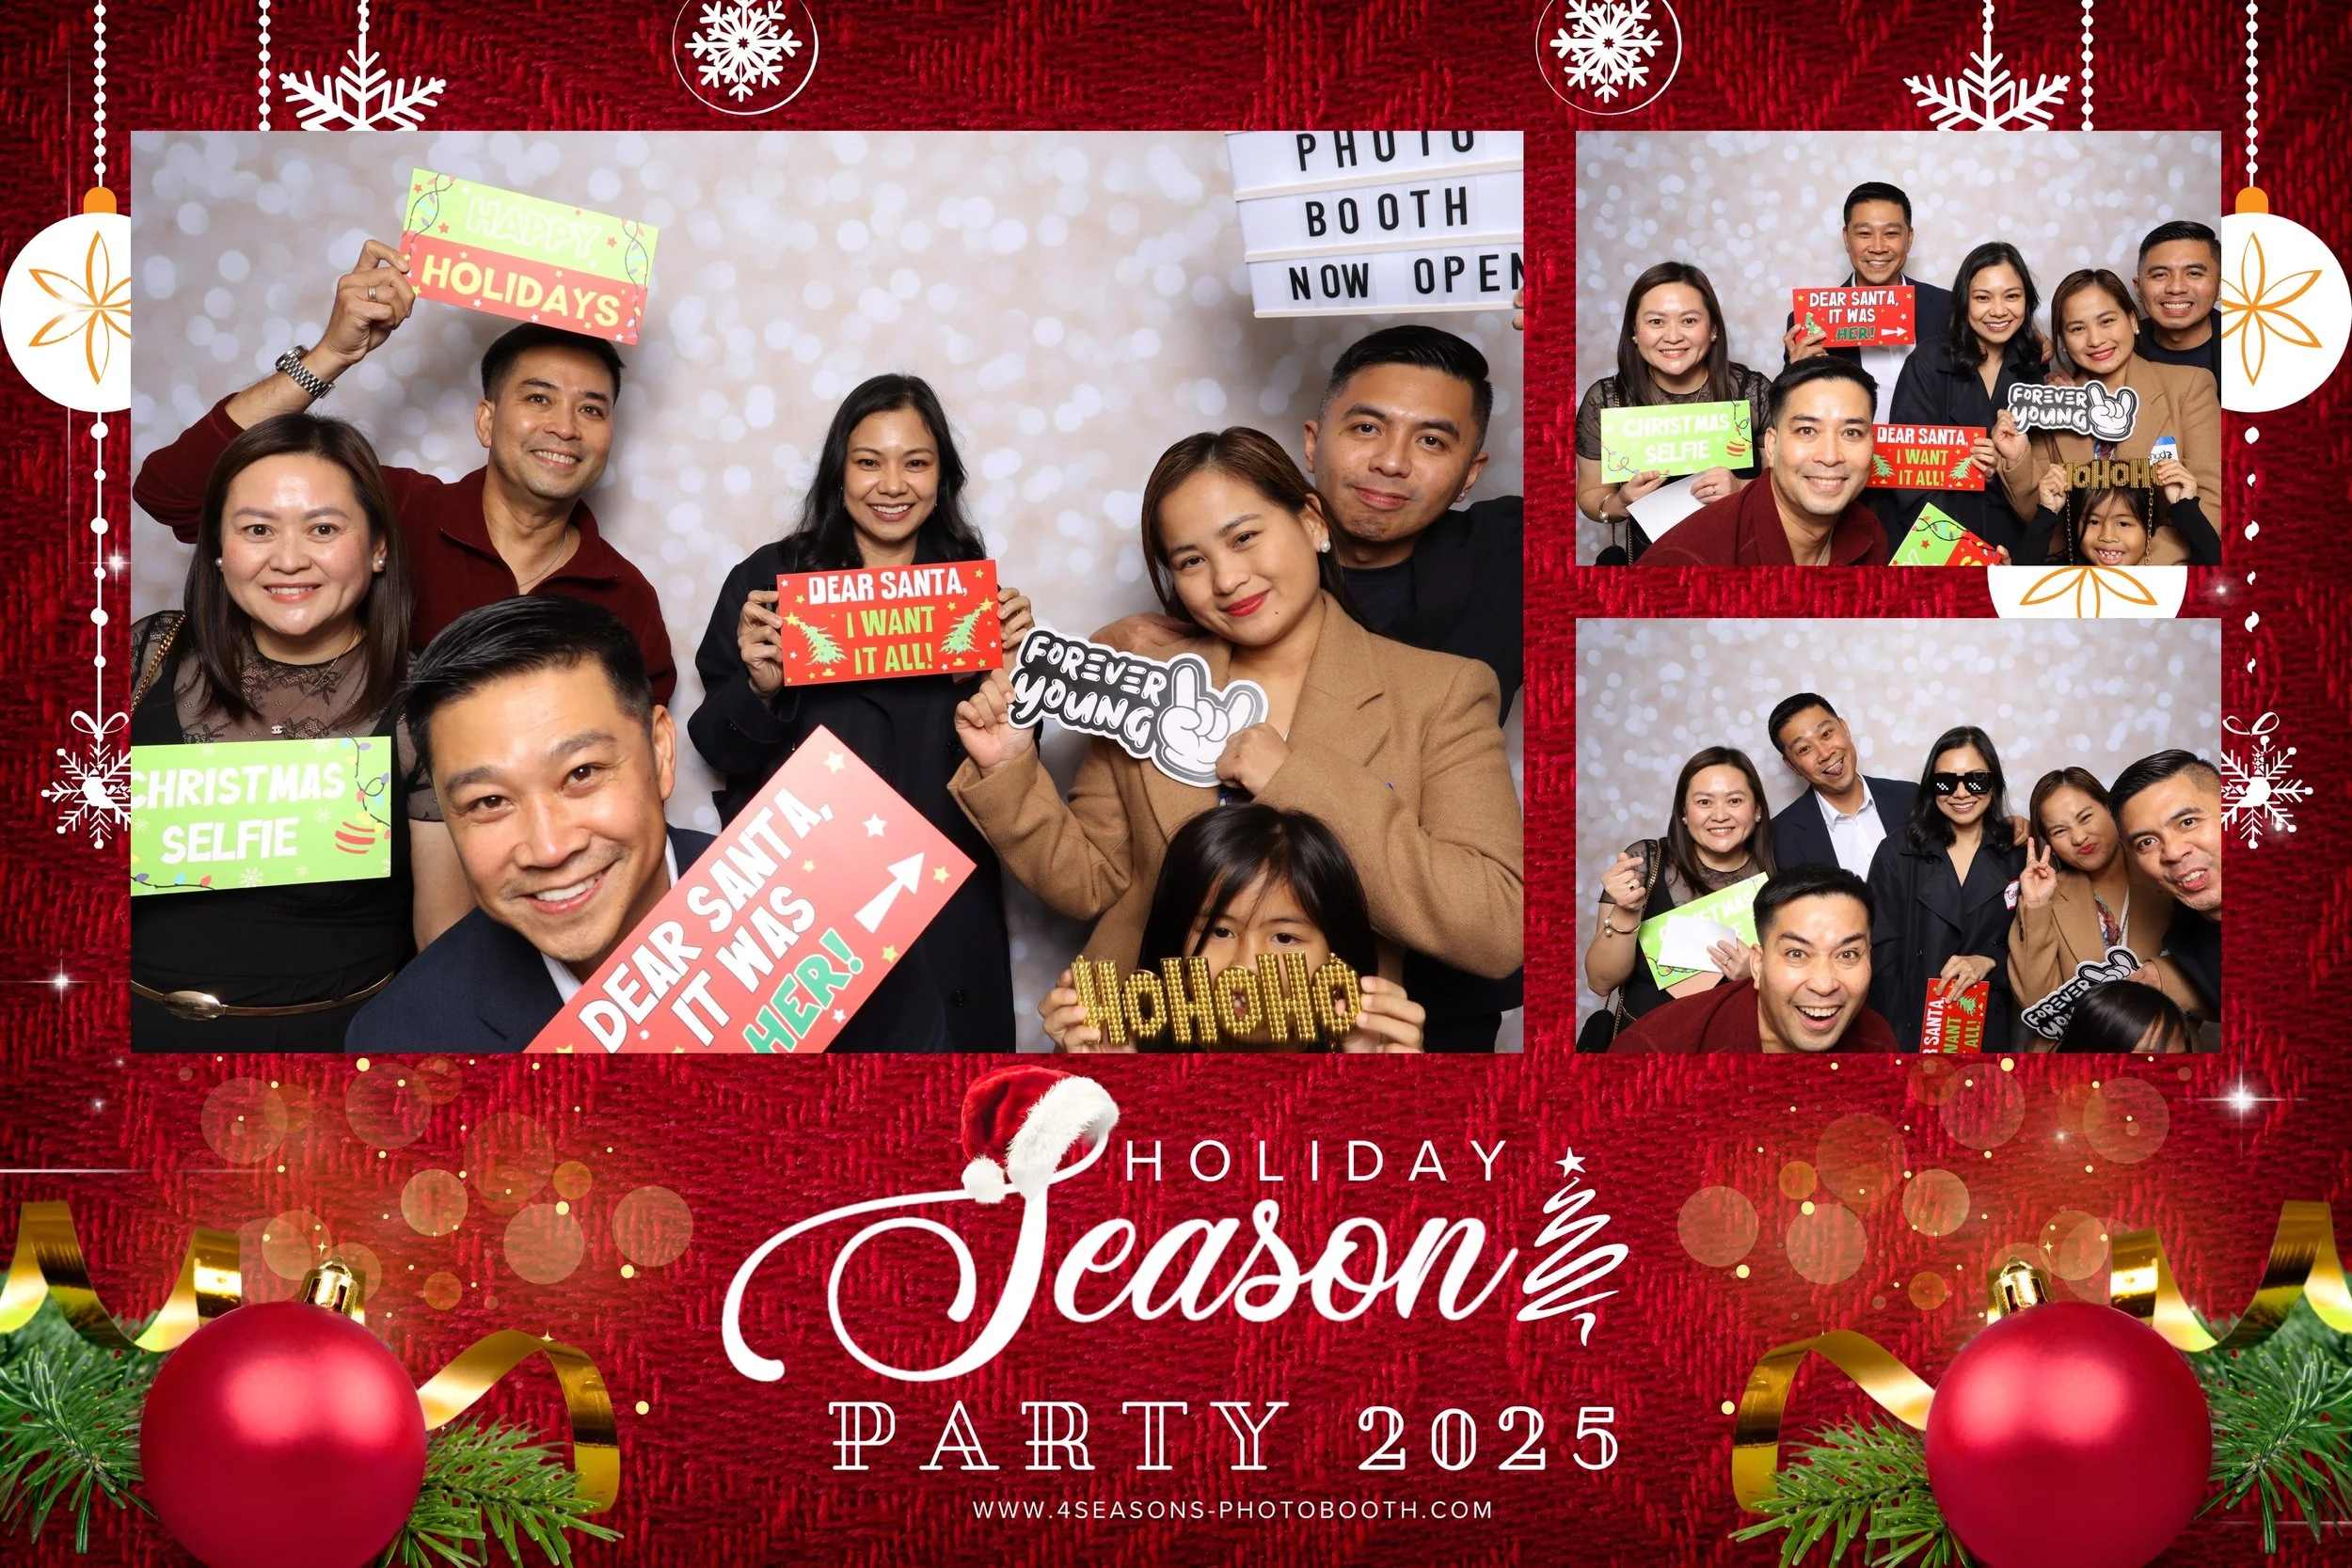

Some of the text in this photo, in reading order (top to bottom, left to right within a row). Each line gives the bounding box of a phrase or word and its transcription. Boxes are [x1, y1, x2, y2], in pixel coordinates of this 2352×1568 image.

[465, 197, 602, 259] HAPPY
[1305, 186, 1468, 237] BOOTH
[421, 254, 621, 327] HOLIDAYS
[1288, 252, 1524, 300] NOW OPEN
[1809, 290, 1899, 308] DEAR SANTA,
[1828, 308, 1876, 325] IT WAS
[1836, 326, 1876, 341] HER!
[2012, 387, 2088, 409] FOREVER
[1622, 412, 1731, 438] CHRISTMAS
[2011, 405, 2088, 431] YOUNG
[1644, 439, 1711, 465] SELFIE
[1876, 426, 1969, 447] DEAR SANTA,
[1896, 448, 1949, 466] I WANT
[1898, 469, 1945, 487] IT ALL!
[807, 566, 968, 606] DEAR SANTA,
[846, 605, 936, 639] I WANT
[854, 642, 934, 675] IT ALL!
[1025, 635, 1168, 706] FOREVER
[1013, 672, 1155, 749] YOUNG
[131, 762, 346, 810] CHRISTMAS
[160, 816, 300, 864] SELFIE
[577, 785, 834, 1053] DEAR SANTA,
[669, 885, 816, 1048] IT WAS
[740, 927, 865, 1053] HER!
[1963, 1021, 1981, 1049] ALL!
